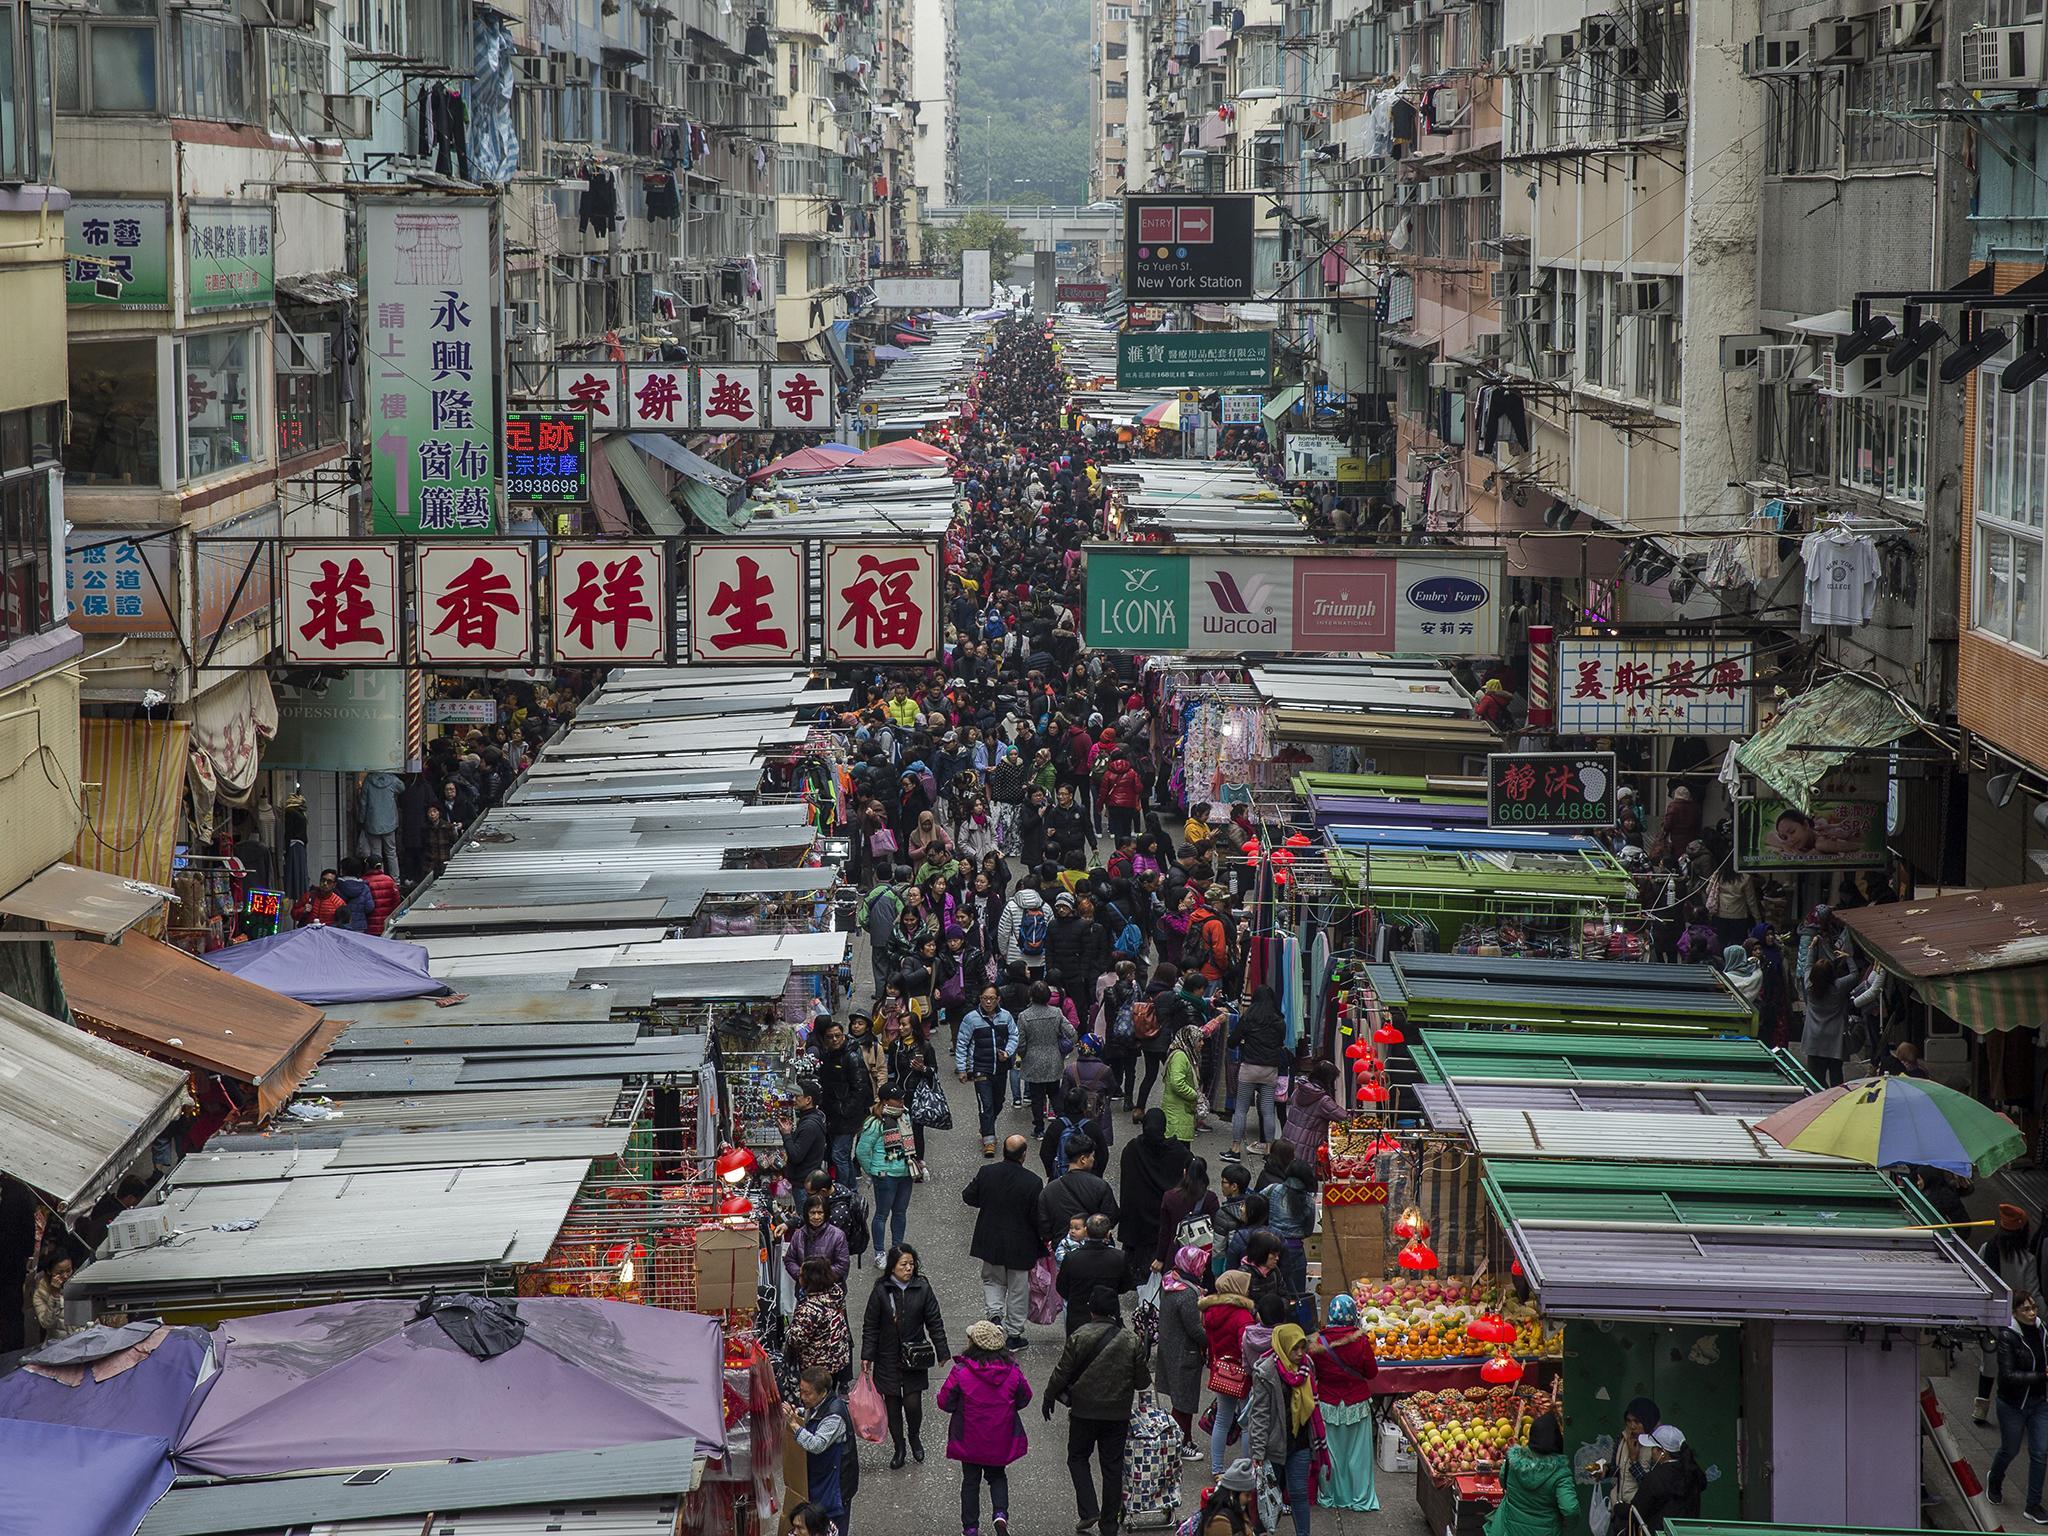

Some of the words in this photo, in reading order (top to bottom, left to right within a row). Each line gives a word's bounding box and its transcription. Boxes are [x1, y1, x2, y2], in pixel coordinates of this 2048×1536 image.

[82, 218, 141, 247] 布藝
[1142, 219, 1172, 228] ENTRY
[192, 224, 269, 259] 永興隆窗簾布藝
[1137, 262, 1150, 271] Fa
[1153, 262, 1178, 271] Yuen
[1180, 262, 1193, 271] St.
[1137, 276, 1165, 288] New
[1169, 276, 1196, 289] York
[1199, 276, 1243, 289] Station
[377, 302, 408, 420] 請上一樓
[429, 290, 474, 432] 永興隆
[507, 479, 579, 493] 23938698
[65, 544, 141, 565] 悠久
[65, 570, 142, 591] 公道
[1415, 590, 1449, 604] Embry
[1454, 590, 1482, 603] Form
[1101, 598, 1177, 635] LEONA
[1311, 598, 1377, 619] Triumph
[1203, 616, 1278, 635] Wacoal
[1421, 621, 1474, 636] 安莉芳
[1570, 657, 1744, 700] 美斯髮廊
[1496, 763, 1580, 801] 靜沐
[1499, 804, 1549, 821] 6604
[1555, 802, 1607, 820] 4886
[1842, 819, 1870, 832] SPA
